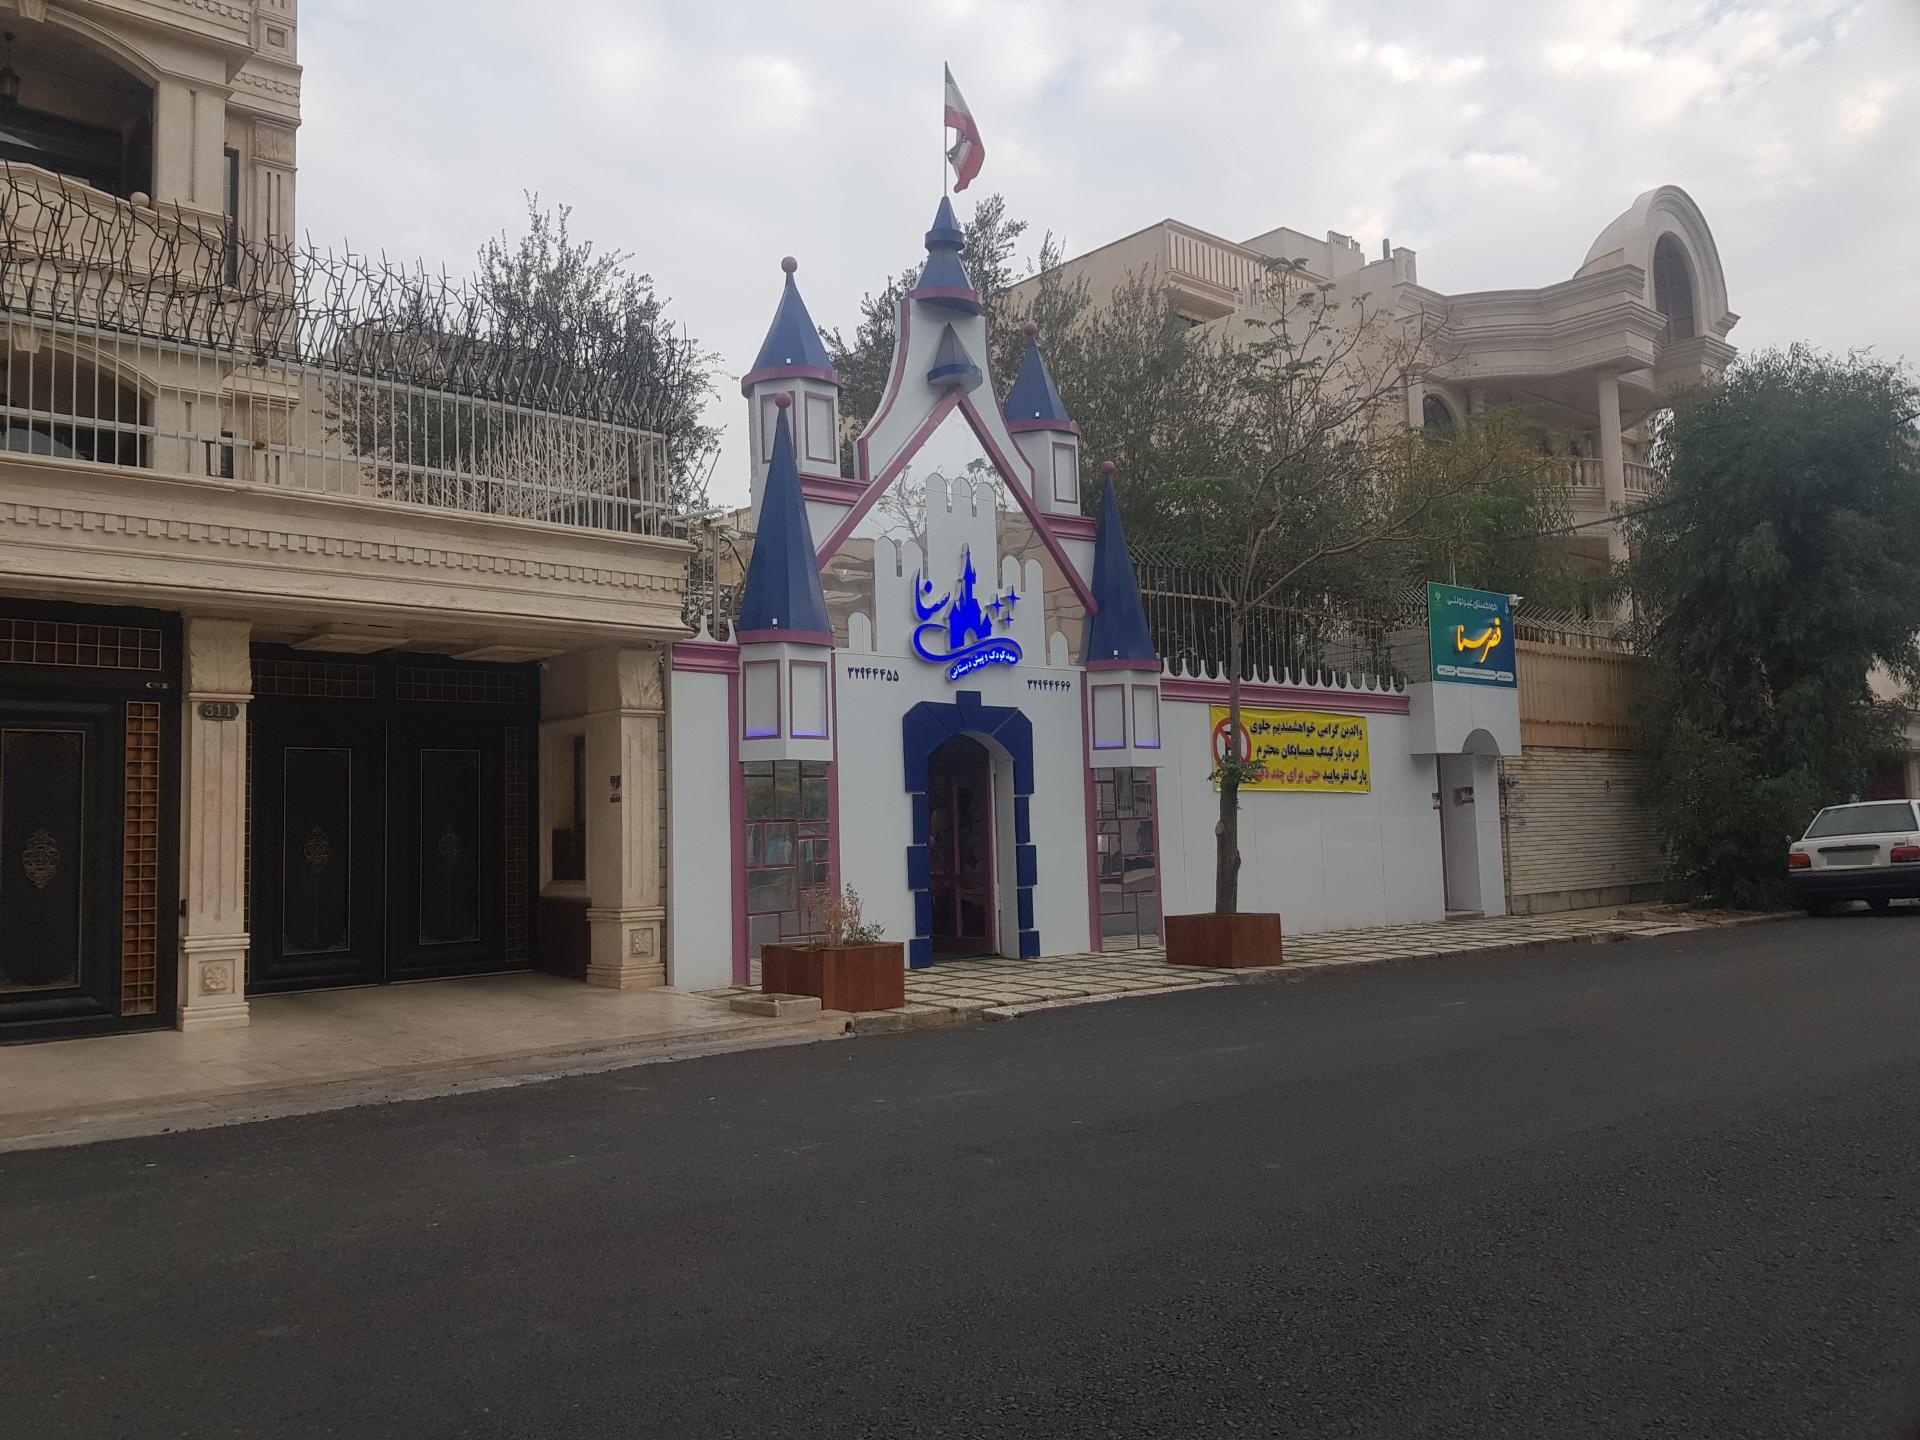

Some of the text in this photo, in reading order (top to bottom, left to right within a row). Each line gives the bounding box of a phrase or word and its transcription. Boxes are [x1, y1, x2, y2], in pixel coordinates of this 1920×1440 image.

[973, 655, 985, 667] پیش
[847, 666, 900, 682] ۳۲۹۴۴۴۵۵
[950, 660, 972, 679] دبستانی
[1027, 679, 1071, 693] ۳۲۹۴۴۴۶۶
[205, 703, 232, 717] 311
[1250, 718, 1363, 740] والدین گرامی خواهشمندیم جلوی
[1257, 744, 1360, 762] درب پارکینگ همسایگان محترم
[1287, 767, 1305, 784] برای
[1305, 768, 1321, 784] حتی
[1322, 767, 1351, 784] نفرمایید
[1352, 768, 1369, 784] پارک
